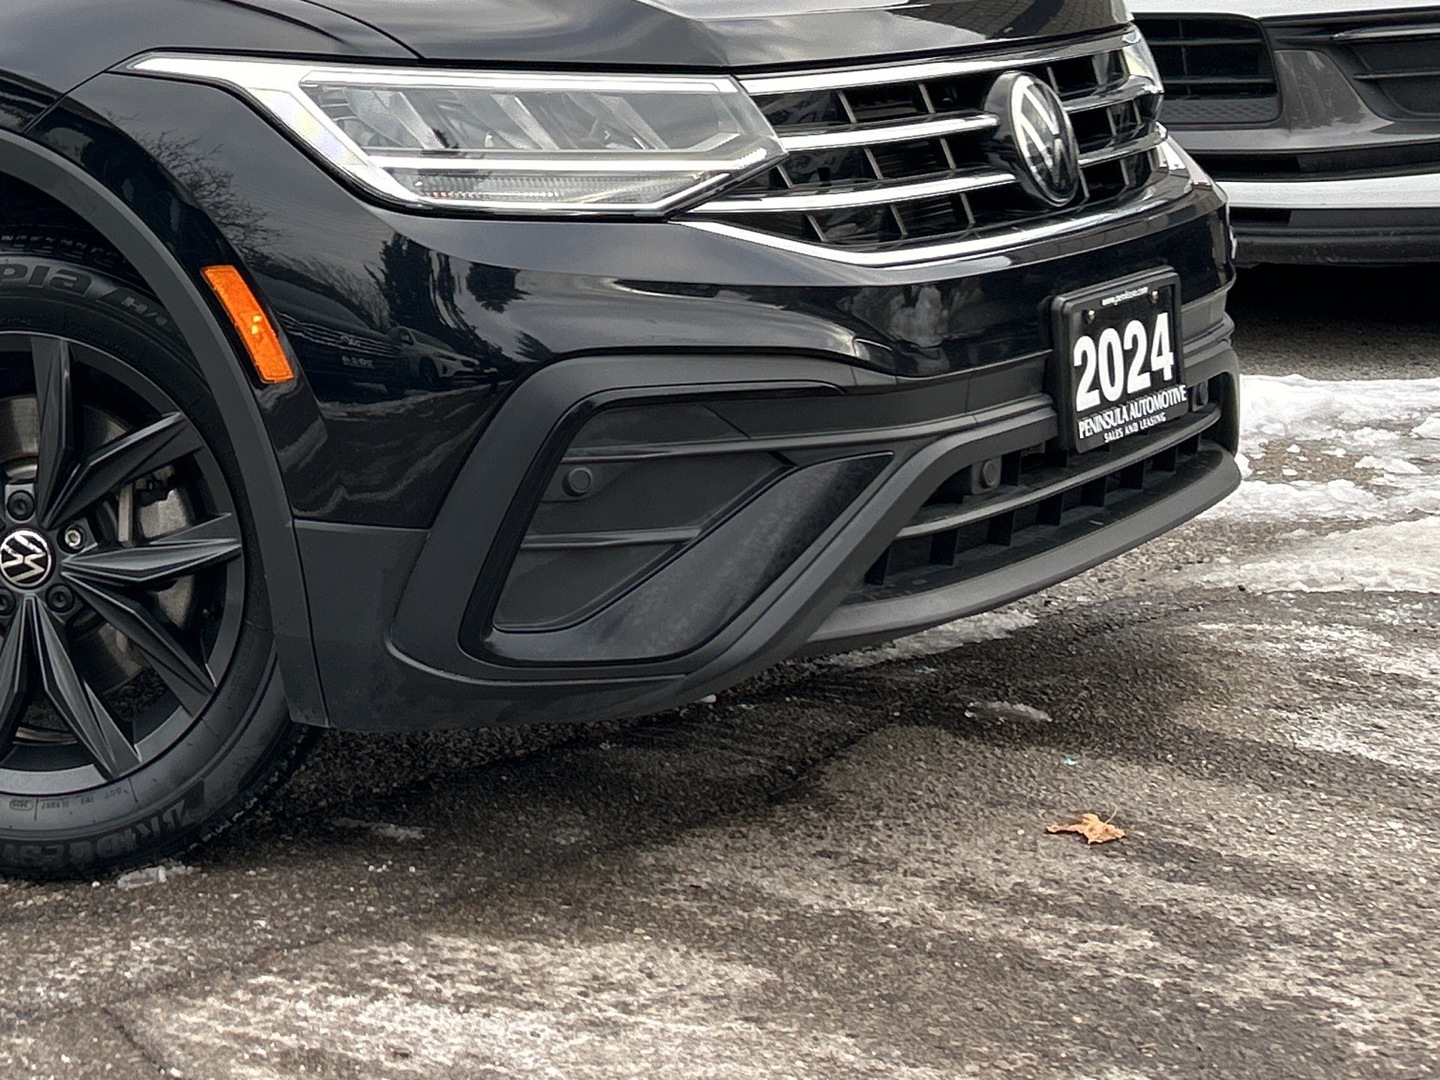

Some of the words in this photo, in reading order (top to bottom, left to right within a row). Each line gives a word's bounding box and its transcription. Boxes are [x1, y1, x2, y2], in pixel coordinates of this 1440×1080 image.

[1073, 312, 1175, 412] 2024
[1078, 404, 1129, 439] PENINSULA
[1129, 385, 1187, 420] AUTOMOTIVE
[1104, 427, 1124, 443] SALES
[1124, 422, 1139, 436] AND
[1139, 412, 1167, 430] LEASING
